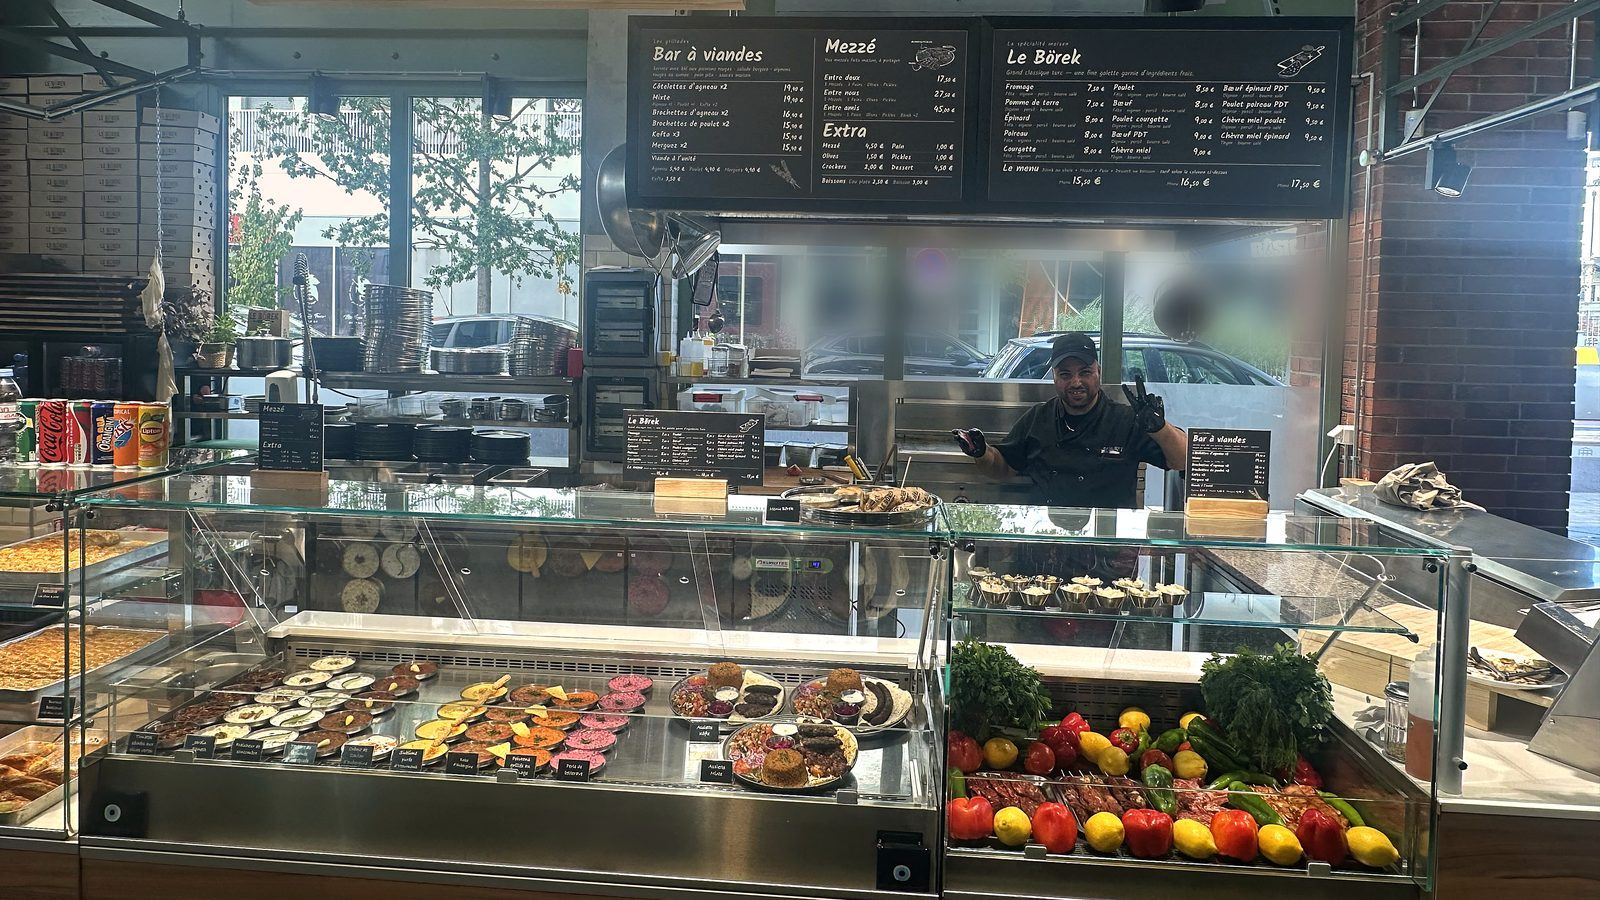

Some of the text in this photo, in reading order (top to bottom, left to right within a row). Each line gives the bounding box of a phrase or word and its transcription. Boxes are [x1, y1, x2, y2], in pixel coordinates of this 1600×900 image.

[826, 38, 876, 53] Mezzé
[653, 46, 762, 61] Bar à viandes
[1008, 49, 1081, 64] Le Börek
[689, 82, 717, 92] d'agneau
[1006, 84, 1034, 92] Fromage
[1246, 85, 1271, 93] épinard
[690, 109, 718, 117] d'agneau
[1005, 112, 1030, 122] Épinard
[824, 123, 866, 137] Extra
[1004, 146, 1036, 154] Courgette
[1073, 176, 1090, 186] 15,50
[1181, 178, 1199, 188] 16,50
[1292, 180, 1309, 189] 17,50
